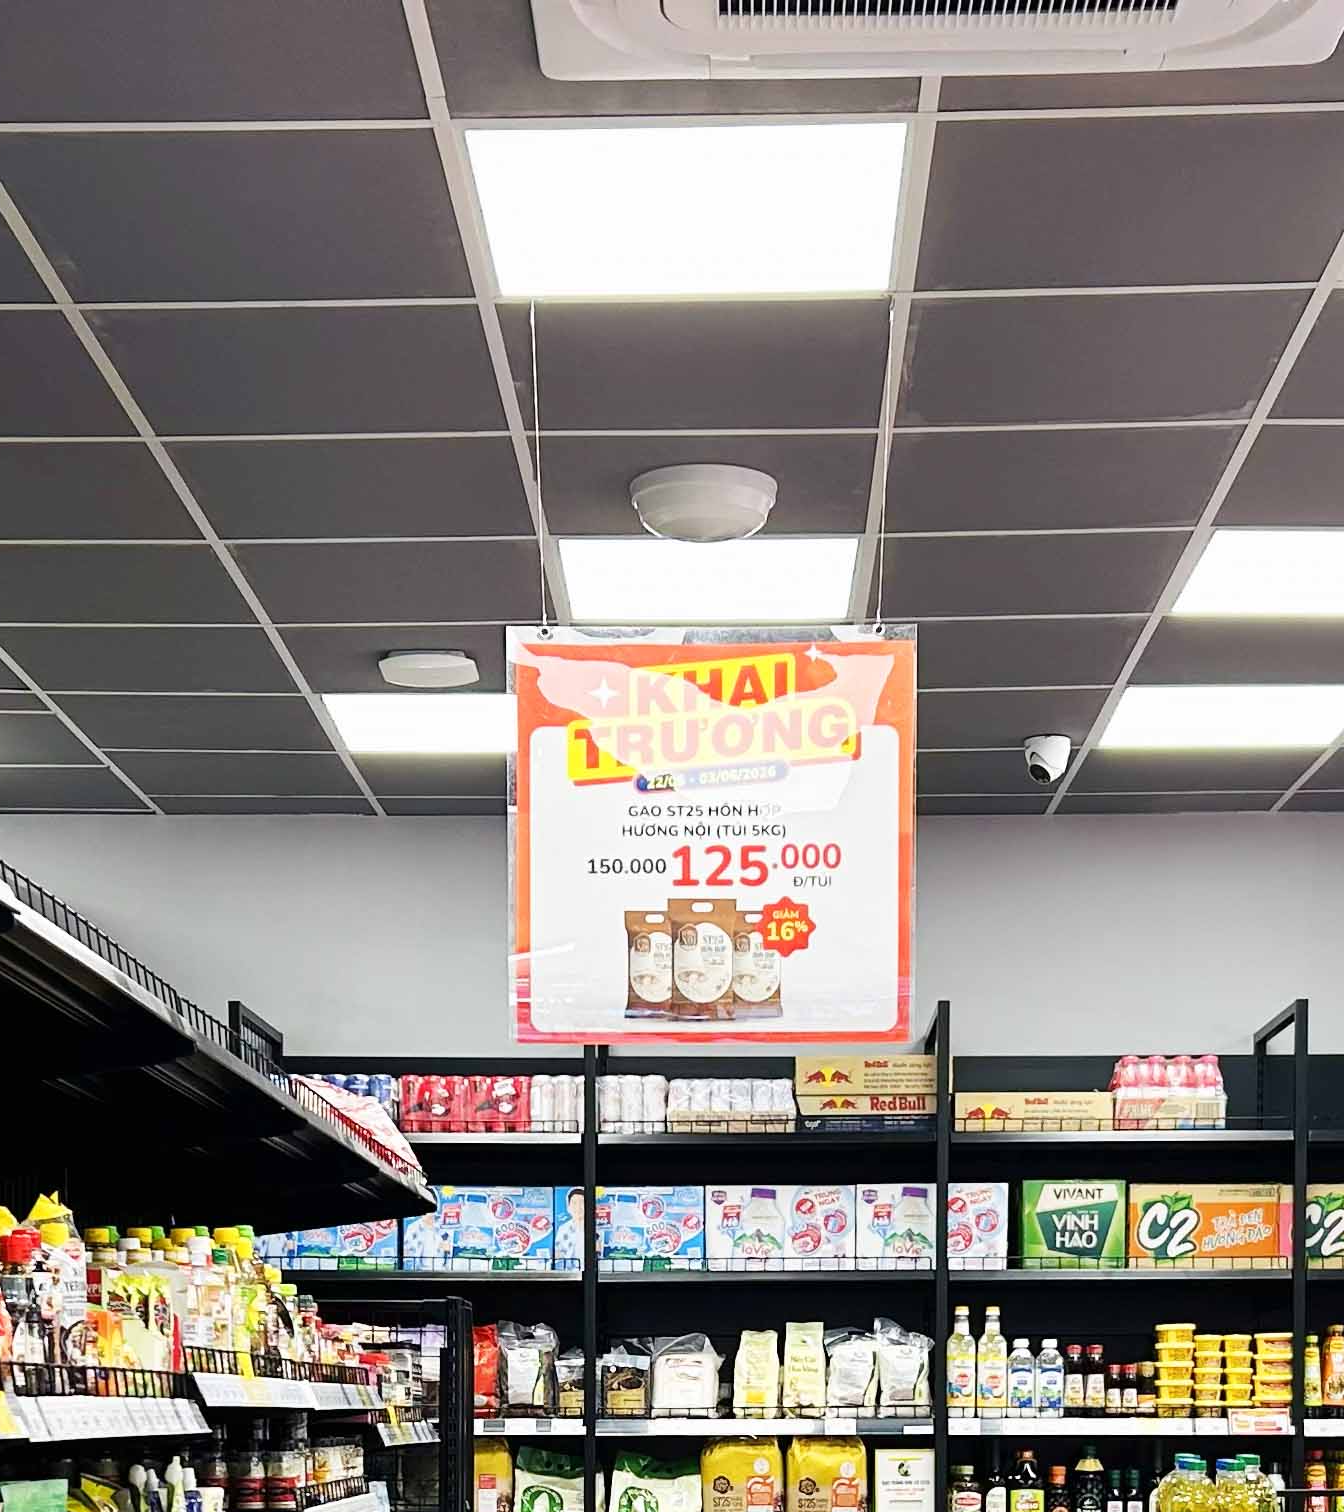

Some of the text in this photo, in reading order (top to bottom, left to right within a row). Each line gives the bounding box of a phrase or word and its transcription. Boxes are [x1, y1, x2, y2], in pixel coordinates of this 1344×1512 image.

[635, 662, 792, 720] KHAI
[667, 804, 704, 818] ST25
[622, 822, 679, 838] HƯƠNG
[684, 820, 711, 841] NỘI
[752, 823, 787, 839] 5KG)
[587, 857, 668, 876] 150.000
[767, 918, 809, 943] 16%
[869, 1095, 926, 1112] Red Bull
[1053, 1187, 1105, 1201] VIVANT
[1137, 1202, 1199, 1257] C2
